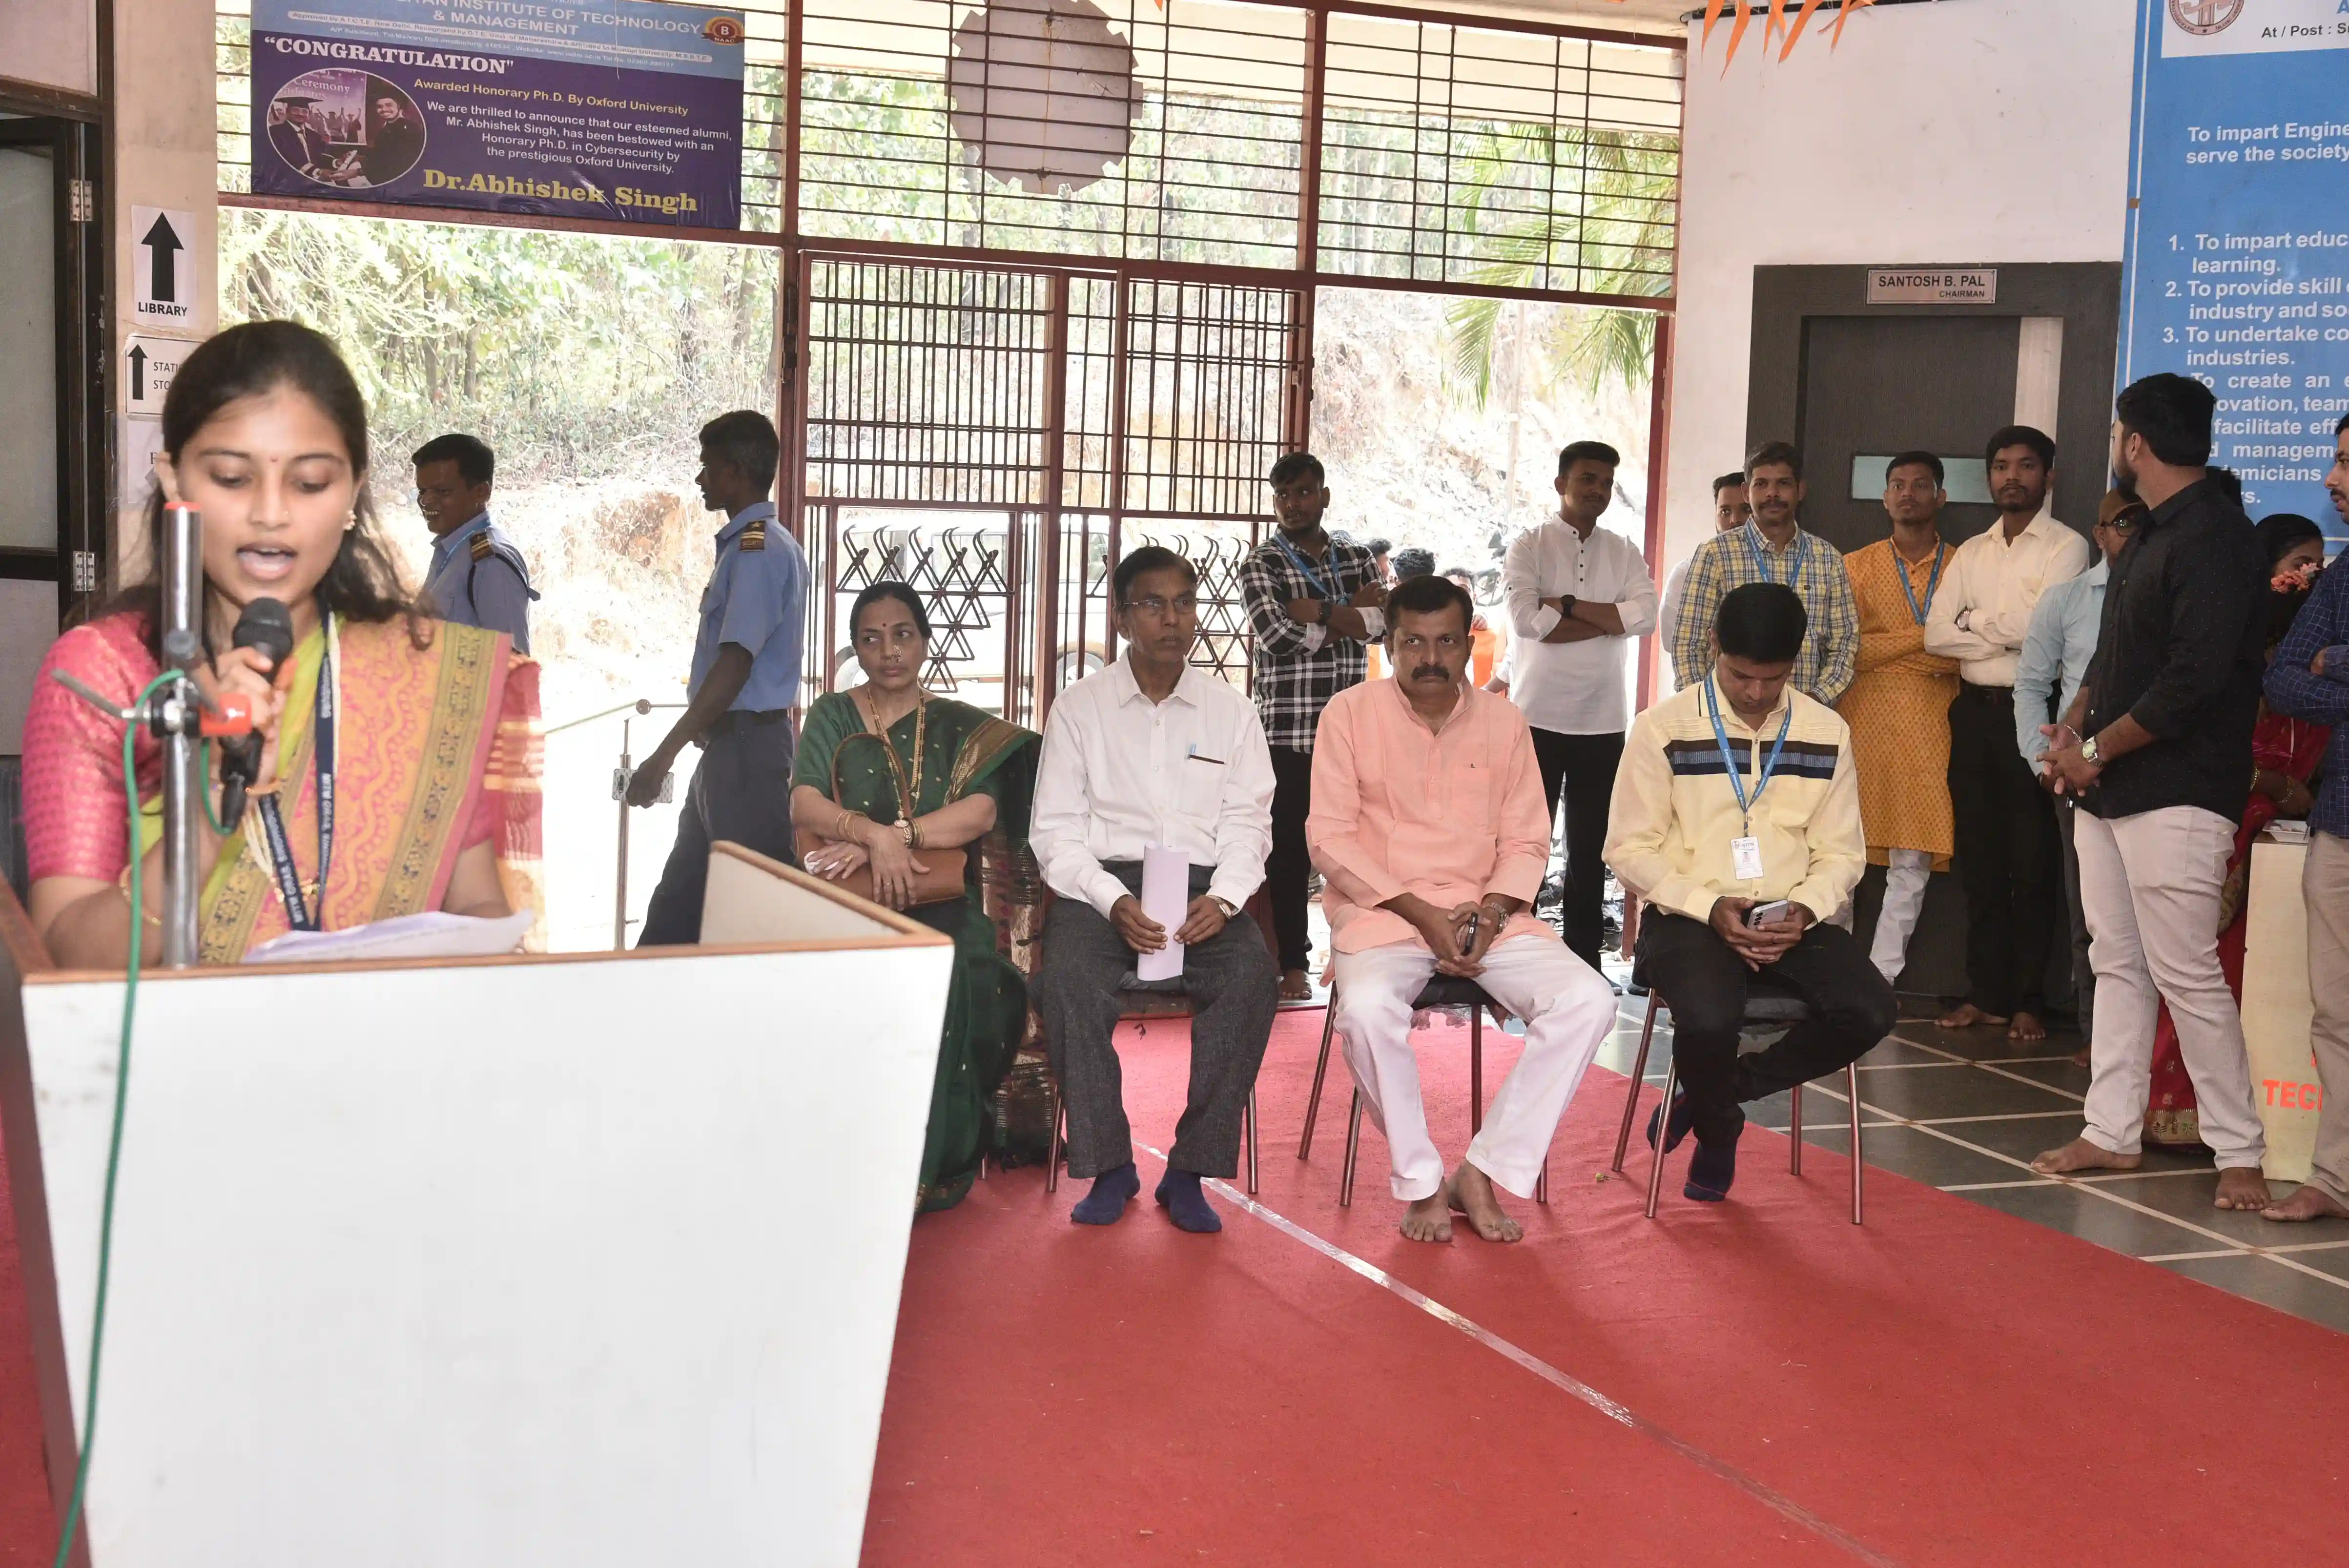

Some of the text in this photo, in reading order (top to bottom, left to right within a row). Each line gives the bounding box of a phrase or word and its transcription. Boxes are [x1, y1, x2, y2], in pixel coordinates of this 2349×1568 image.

[433, 10, 579, 35] & MANAGEMENT
[454, 0, 547, 17] INSTITUTE
[552, 9, 576, 21] OF
[580, 11, 701, 34] TECHNOLOGY
[721, 25, 729, 35] B
[2261, 26, 2278, 39] At
[2281, 25, 2287, 38] /
[2290, 24, 2323, 37] Post
[294, 78, 350, 94] Ceremony
[414, 79, 689, 116] Awarded Honorary Ph.D. By Oxford University
[427, 101, 732, 142] We are thrilled to announce that our esteemed alumni,
[446, 116, 714, 151] Mr. Abhishek Singh, has been bestowed with an
[2187, 121, 2349, 144] To impart Engine
[482, 133, 680, 163] Honorary Ph.D. in Cybersecurity by
[2186, 150, 2239, 165] serve
[2244, 146, 2275, 162] the
[487, 146, 675, 175] the prestigious Oxford University.
[422, 168, 698, 215] Dr.Abhishek Singh
[2168, 230, 2349, 253] 1. To impart educ
[2192, 256, 2281, 276] learning.
[1878, 275, 1985, 287] SANTOSH B. PAL
[2165, 281, 2182, 297] 2.
[2187, 280, 2211, 297] To
[2216, 278, 2294, 300] provide
[2298, 277, 2342, 294] skill
[1939, 290, 1985, 298] CHAIRMAN
[138, 302, 188, 317] LIBRARY
[2189, 303, 2274, 323] industry
[2278, 301, 2318, 319] and
[2163, 327, 2179, 343] 3.
[2185, 326, 2209, 343] To
[2215, 325, 2319, 342] undertake
[2186, 349, 2295, 366] industries.
[153, 362, 179, 374] STATI
[153, 380, 171, 391] STO
[2227, 372, 2292, 389] create
[2305, 375, 2330, 388] an
[2216, 395, 2349, 414] ovation, team
[2214, 418, 2302, 435] facilitate
[2233, 445, 2334, 462] managem
[2231, 465, 2322, 481] emicians
[2262, 1079, 2322, 1113] TEC
